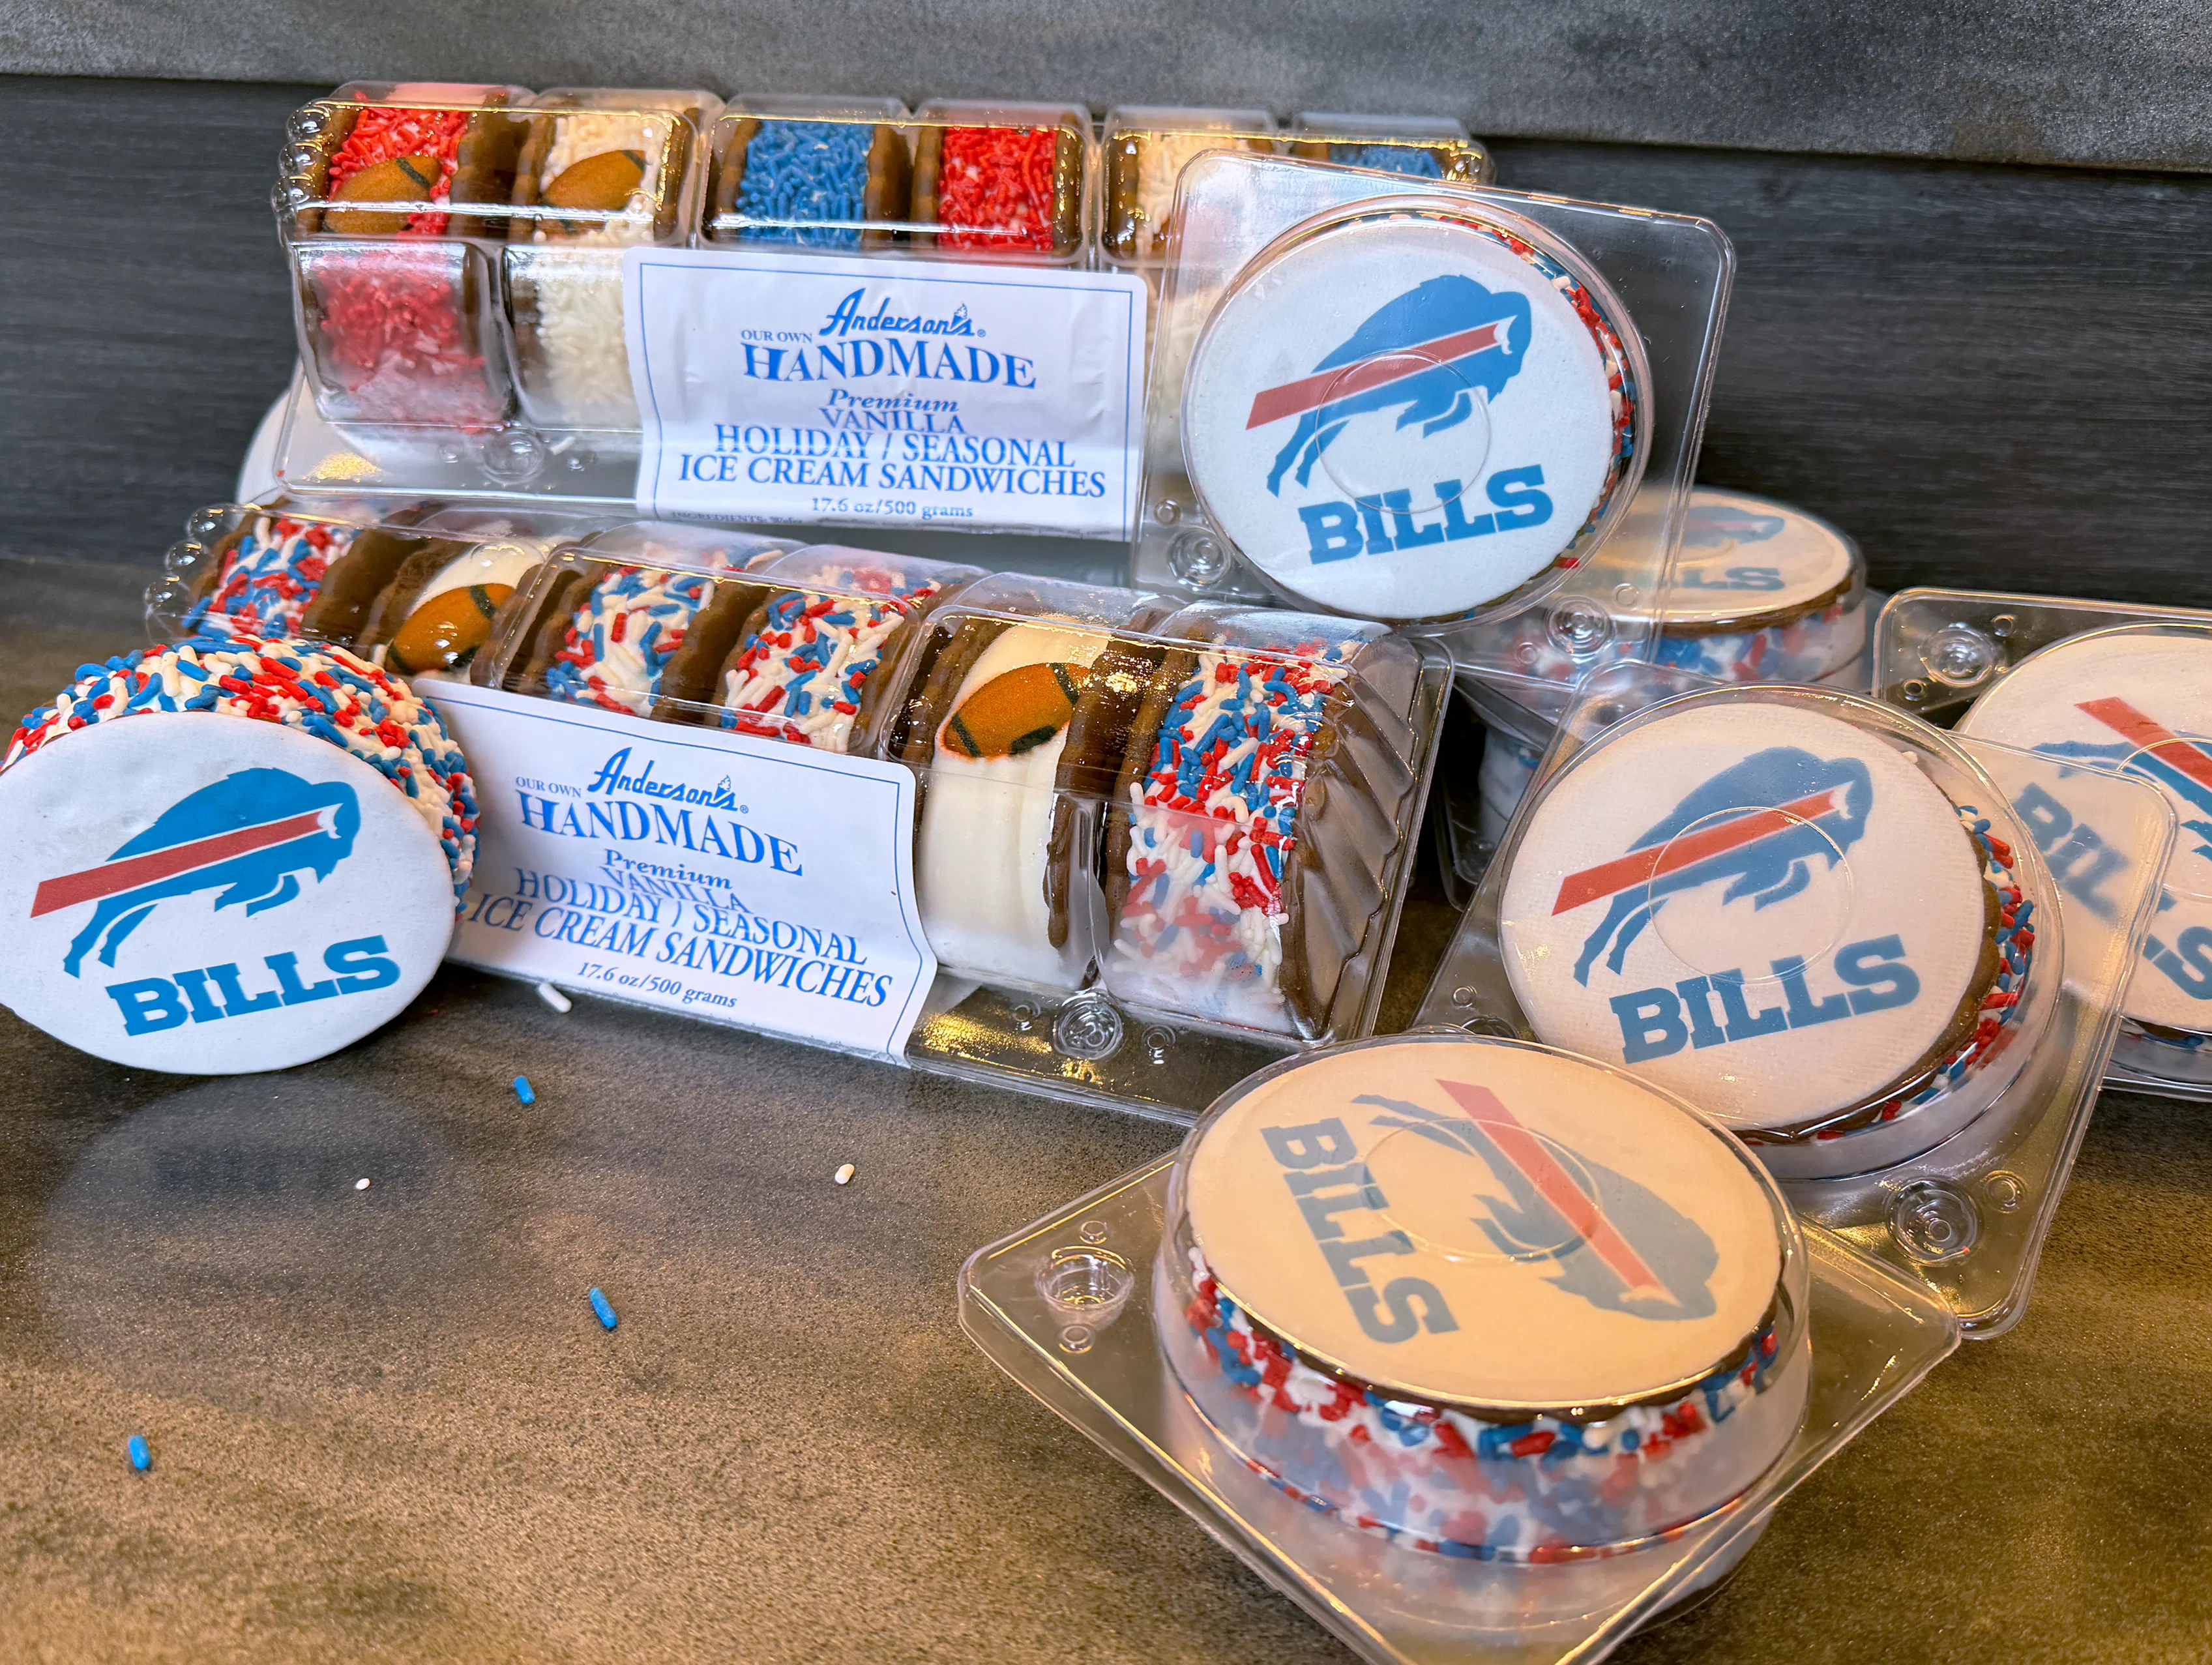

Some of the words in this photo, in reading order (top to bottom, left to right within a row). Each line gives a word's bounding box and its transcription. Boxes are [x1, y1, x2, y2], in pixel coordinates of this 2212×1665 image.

[741, 329, 774, 342] OUR
[777, 331, 812, 344] OWN
[741, 337, 1037, 390] HANDMADE
[818, 407, 967, 434] VANILLA
[827, 389, 960, 413] Premium
[715, 422, 874, 459] HOLIDAY
[881, 432, 893, 460] /
[902, 433, 1076, 467] SEASONAL
[678, 454, 739, 482] ICE
[748, 456, 871, 488] CREAM
[878, 463, 1106, 498] SANDWICHES
[812, 497, 849, 512] 17.6
[854, 499, 916, 515] oz/500
[922, 505, 973, 520] grams
[1297, 464, 1554, 565] BILLS
[516, 776, 545, 791] OUR
[548, 782, 582, 799] OWN
[514, 789, 803, 877] HANDMADE
[599, 866, 754, 914] VANILLA
[604, 848, 733, 889] Premium
[514, 867, 664, 923] HOLIDAY
[693, 904, 868, 965] SEASONAL
[468, 892, 534, 932] ICE
[535, 906, 660, 958] CREAM
[656, 931, 893, 1007] SANDWICHES
[105, 934, 401, 1037] BILLS
[578, 962, 619, 982] 17.6
[619, 974, 683, 995] oz/500
[682, 986, 738, 1008] grams
[1609, 934, 1921, 1064] BILLS
[1259, 1116, 1461, 1344] BILLS
